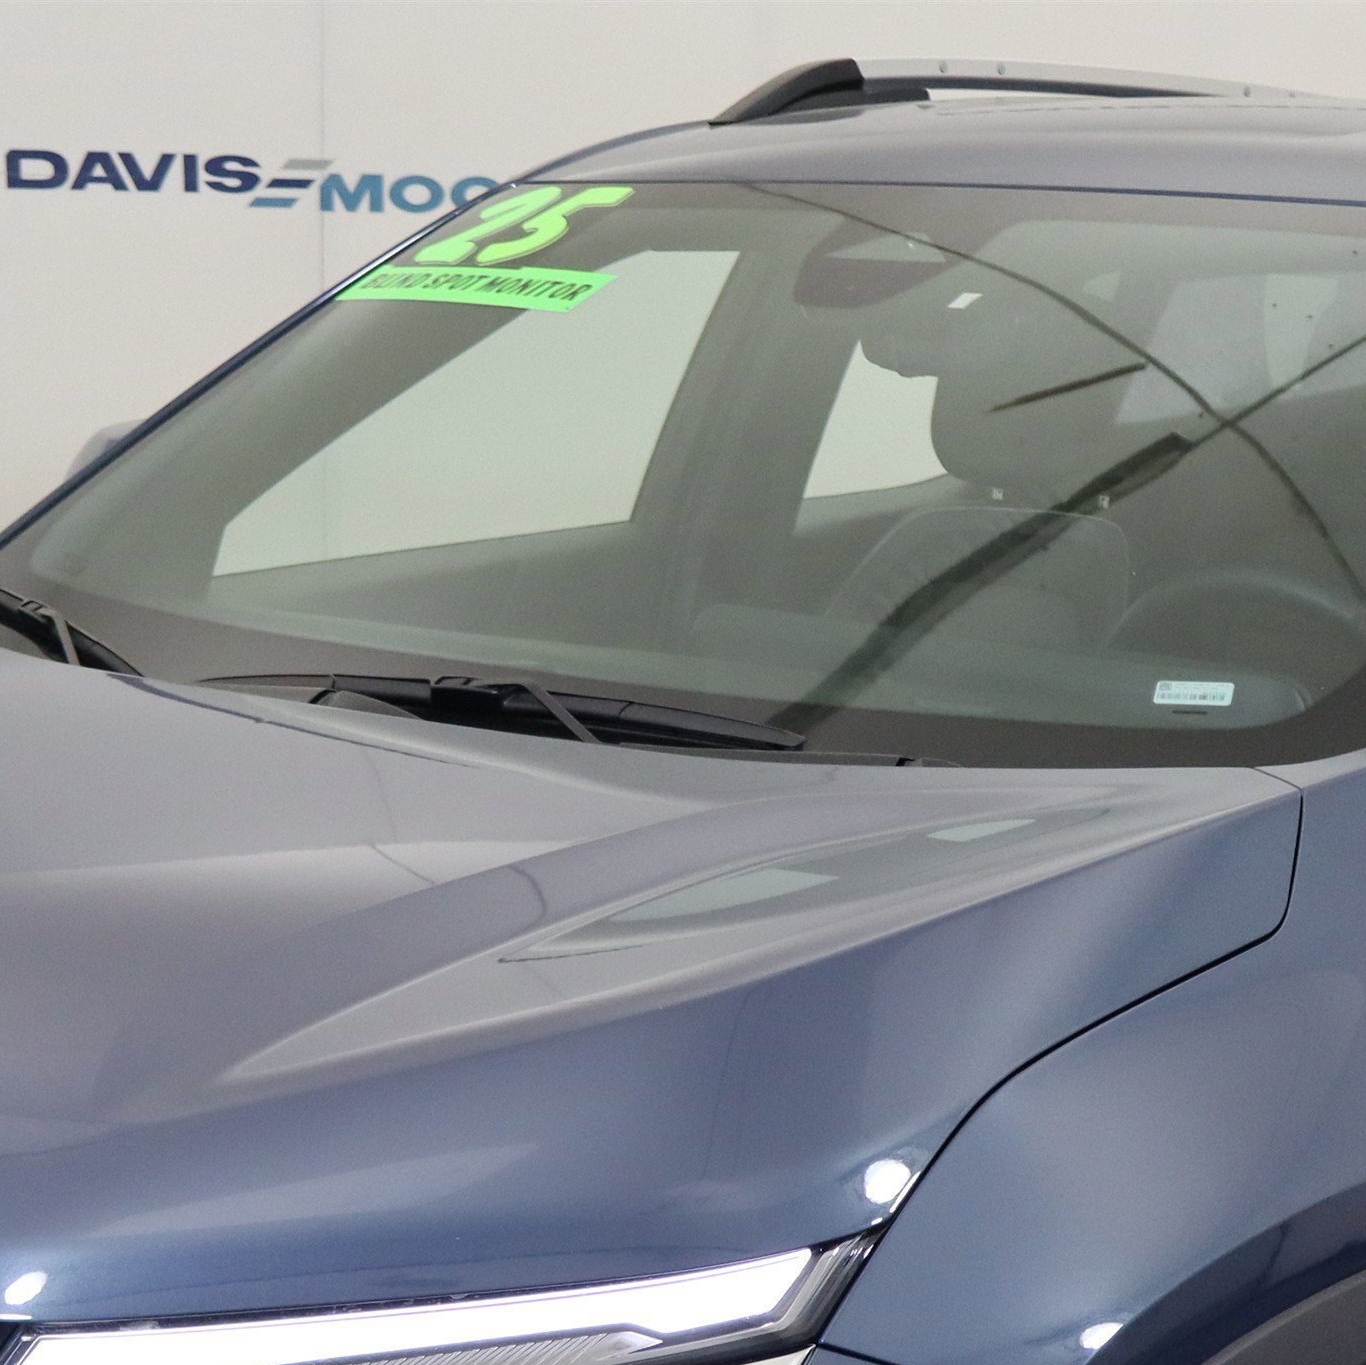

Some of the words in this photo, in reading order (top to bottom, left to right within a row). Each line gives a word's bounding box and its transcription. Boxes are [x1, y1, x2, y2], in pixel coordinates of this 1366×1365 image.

[414, 186, 635, 265] 25
[426, 274, 484, 292] SPOT
[482, 276, 594, 302] MONITOR
